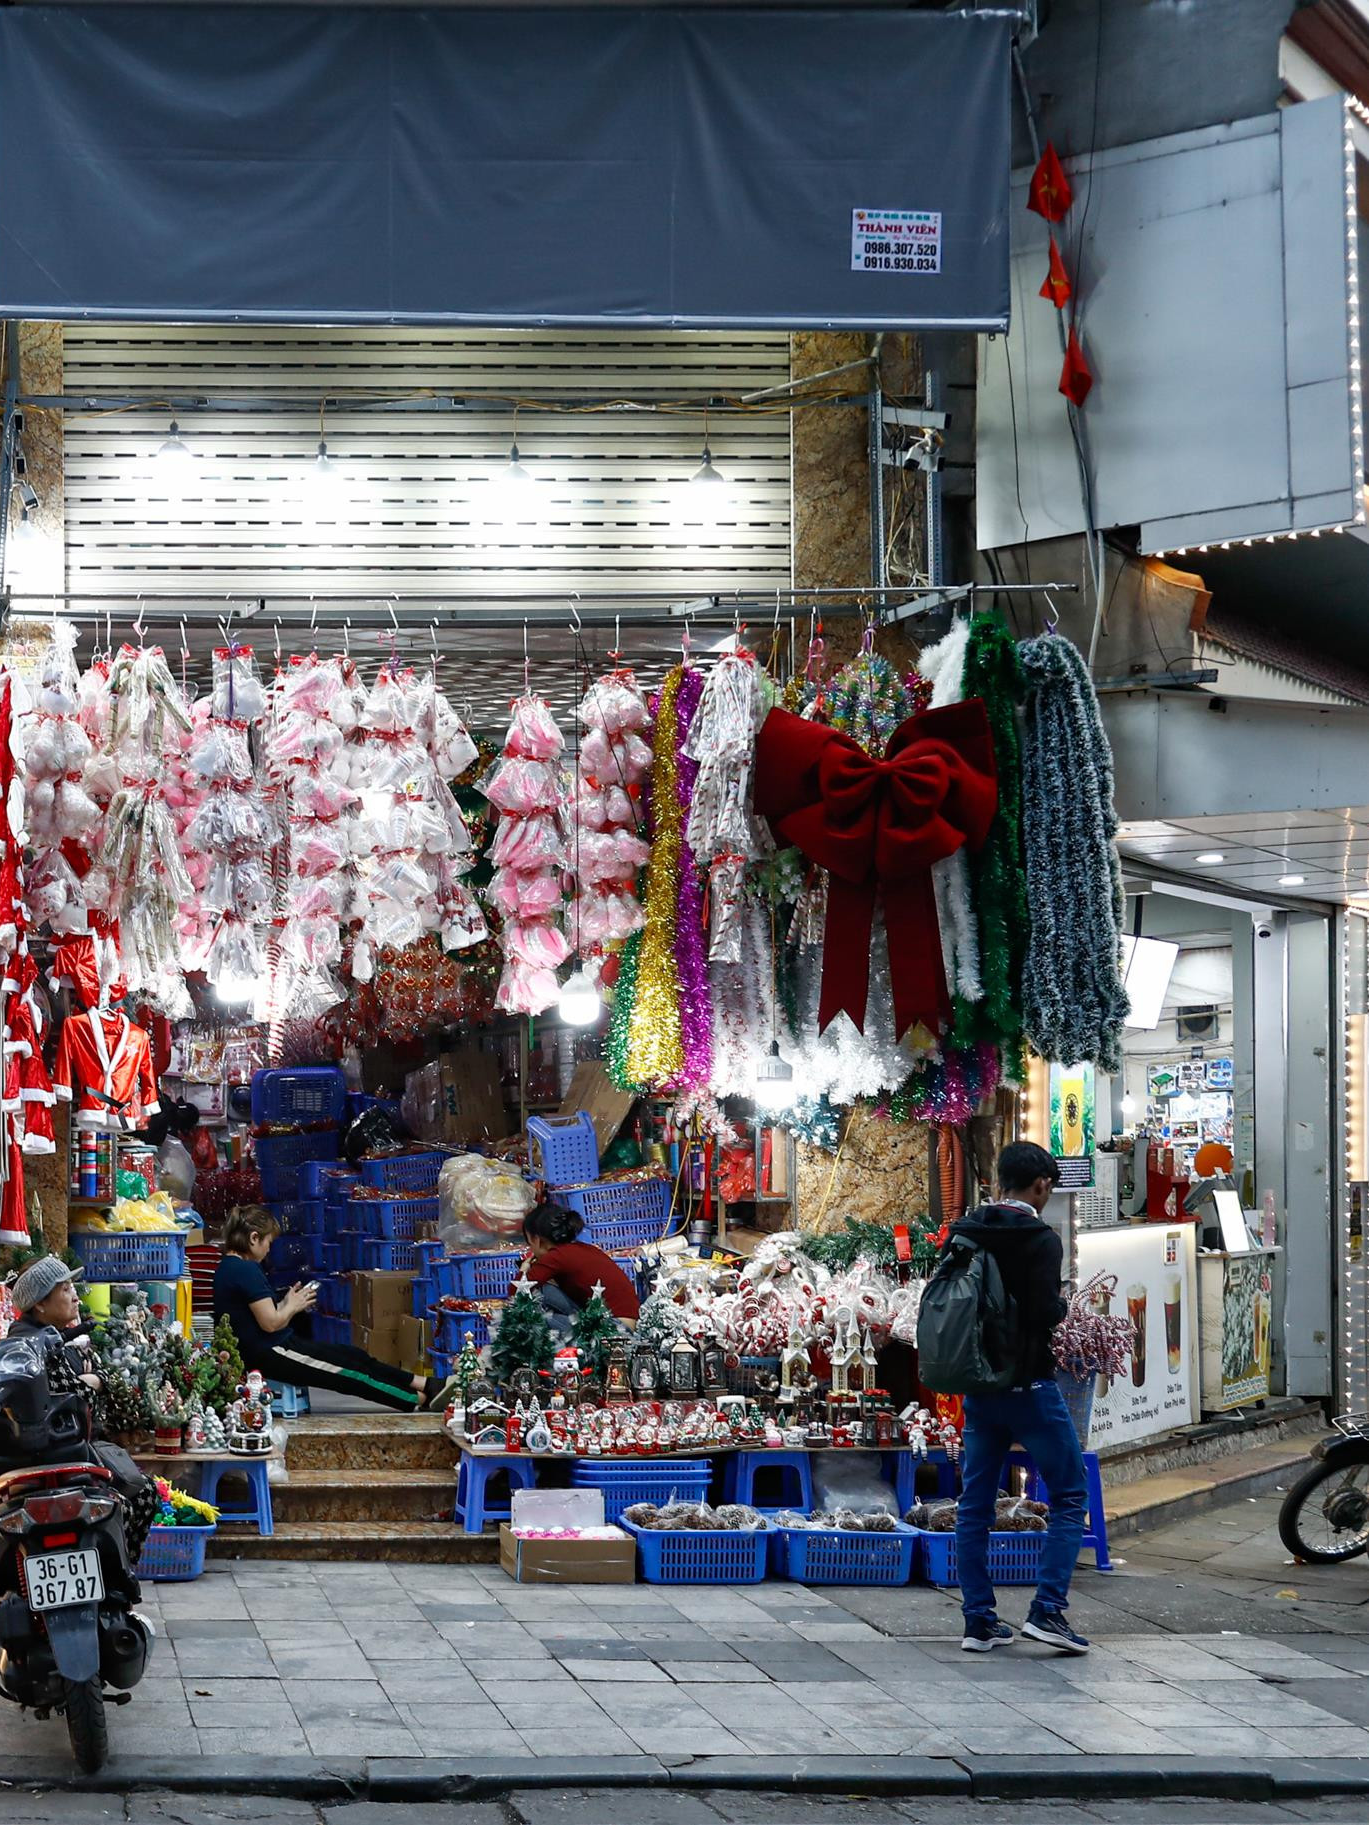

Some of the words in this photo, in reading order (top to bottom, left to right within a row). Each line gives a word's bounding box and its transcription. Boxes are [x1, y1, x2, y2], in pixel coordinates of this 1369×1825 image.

[857, 221, 903, 233] THÀNH
[864, 241, 937, 256] 0986.307.520
[864, 256, 937, 271] 0916.930.034
[35, 1552, 88, 1580] 36-G1
[33, 1576, 97, 1606] 367.87
